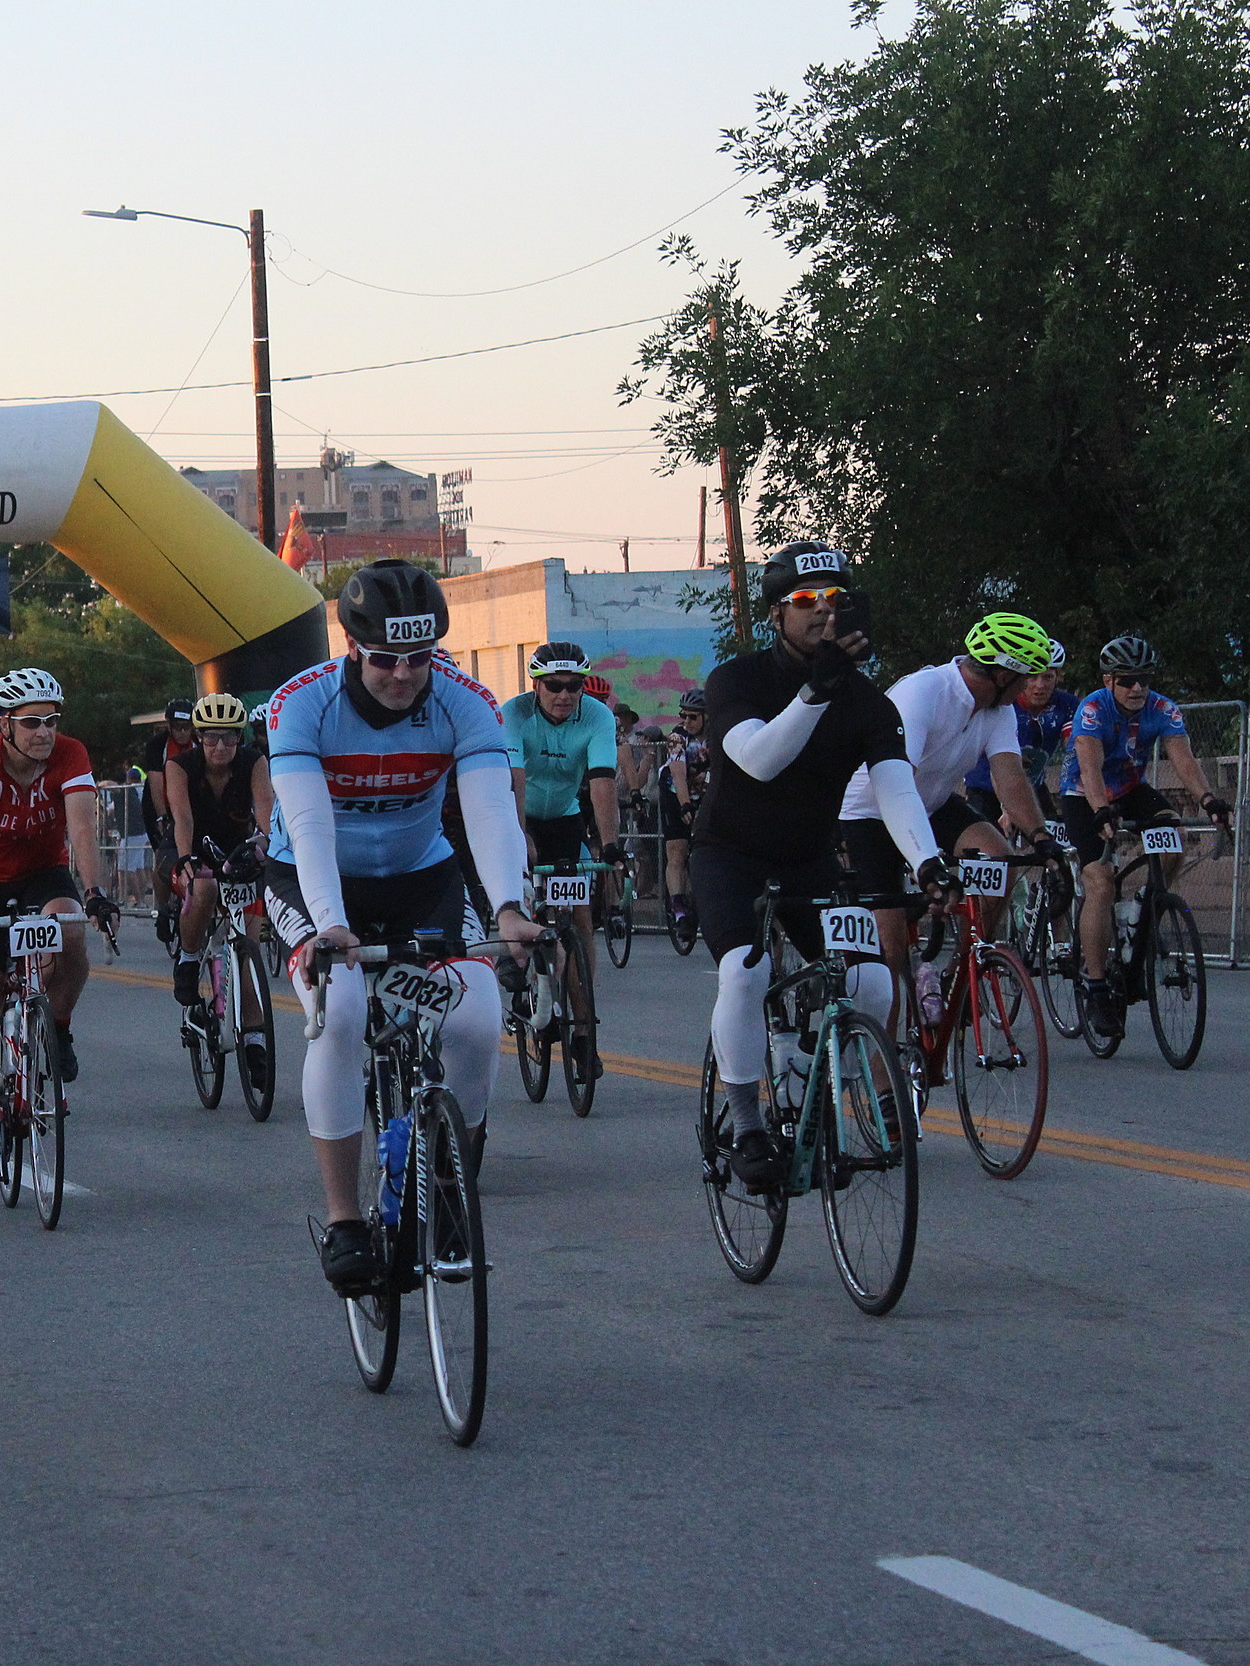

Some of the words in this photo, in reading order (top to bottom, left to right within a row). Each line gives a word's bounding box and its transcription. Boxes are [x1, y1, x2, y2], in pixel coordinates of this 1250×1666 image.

[800, 555, 835, 570] 2012
[390, 619, 432, 640] 2032
[36, 690, 51, 698] 7092
[269, 662, 338, 731] SCHEELS
[430, 660, 504, 725] SCHEELS
[323, 768, 440, 788] SCHEELS
[1146, 831, 1177, 849] 3931
[551, 881, 586, 901] 6440
[963, 866, 1003, 891] 6439
[14, 925, 58, 951] 7092
[830, 915, 876, 946] 2012
[383, 970, 454, 1013] 2032
[416, 1128, 428, 1224] SPECIALIZED
